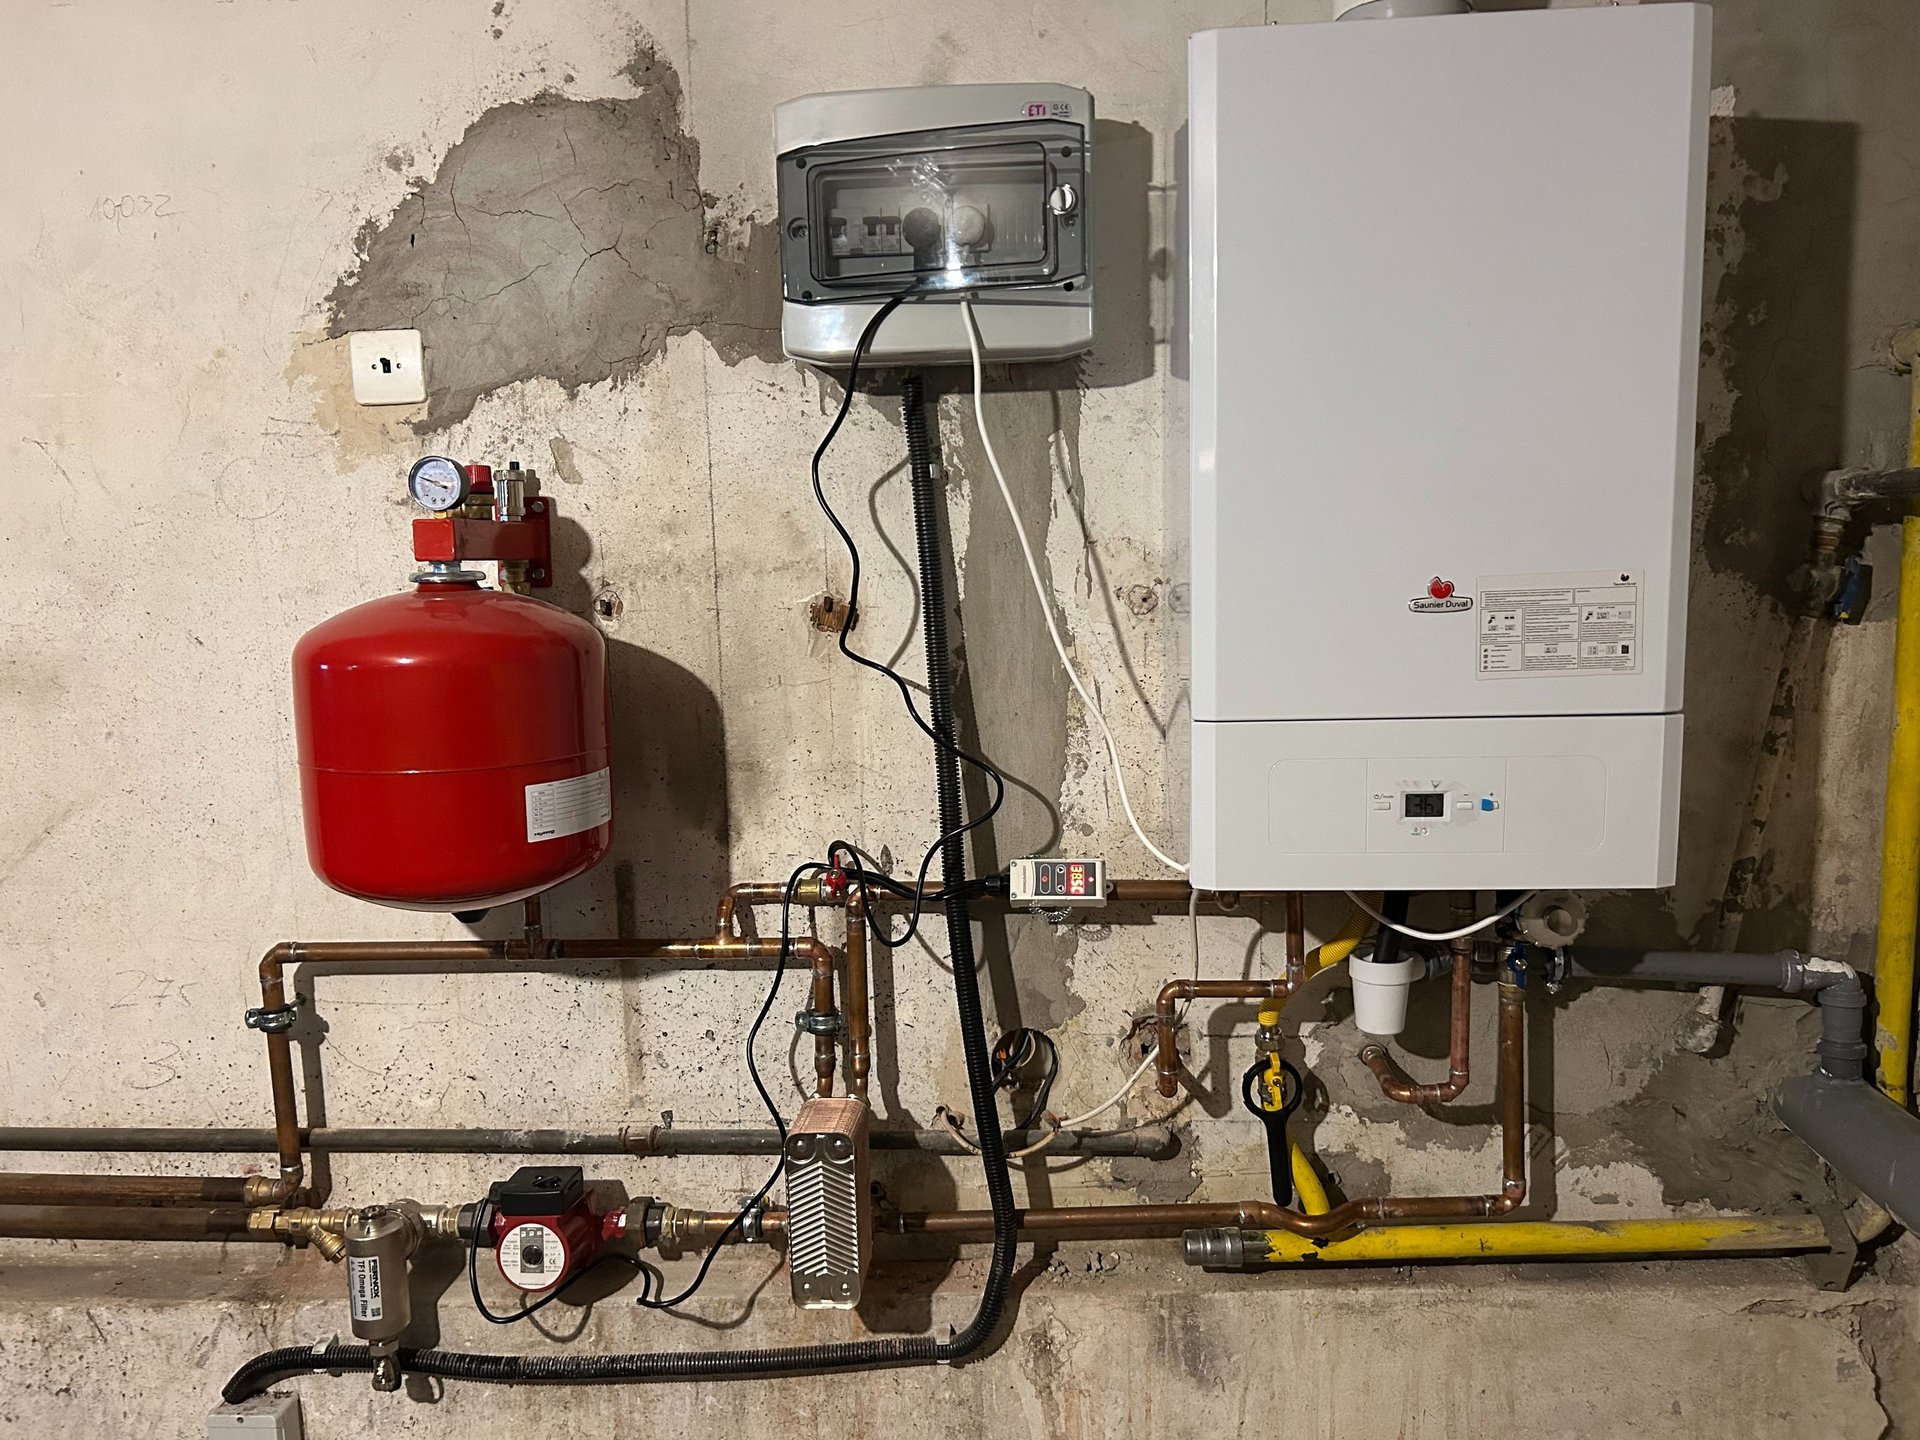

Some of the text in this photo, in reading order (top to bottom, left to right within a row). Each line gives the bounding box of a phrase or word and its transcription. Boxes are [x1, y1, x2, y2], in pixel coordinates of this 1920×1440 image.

[1028, 104, 1046, 117] ETI
[1413, 600, 1469, 609] Saunier Duval
[358, 1260, 366, 1273] TF1
[371, 1259, 380, 1299] FERNOX
[360, 1299, 368, 1318] Filter
